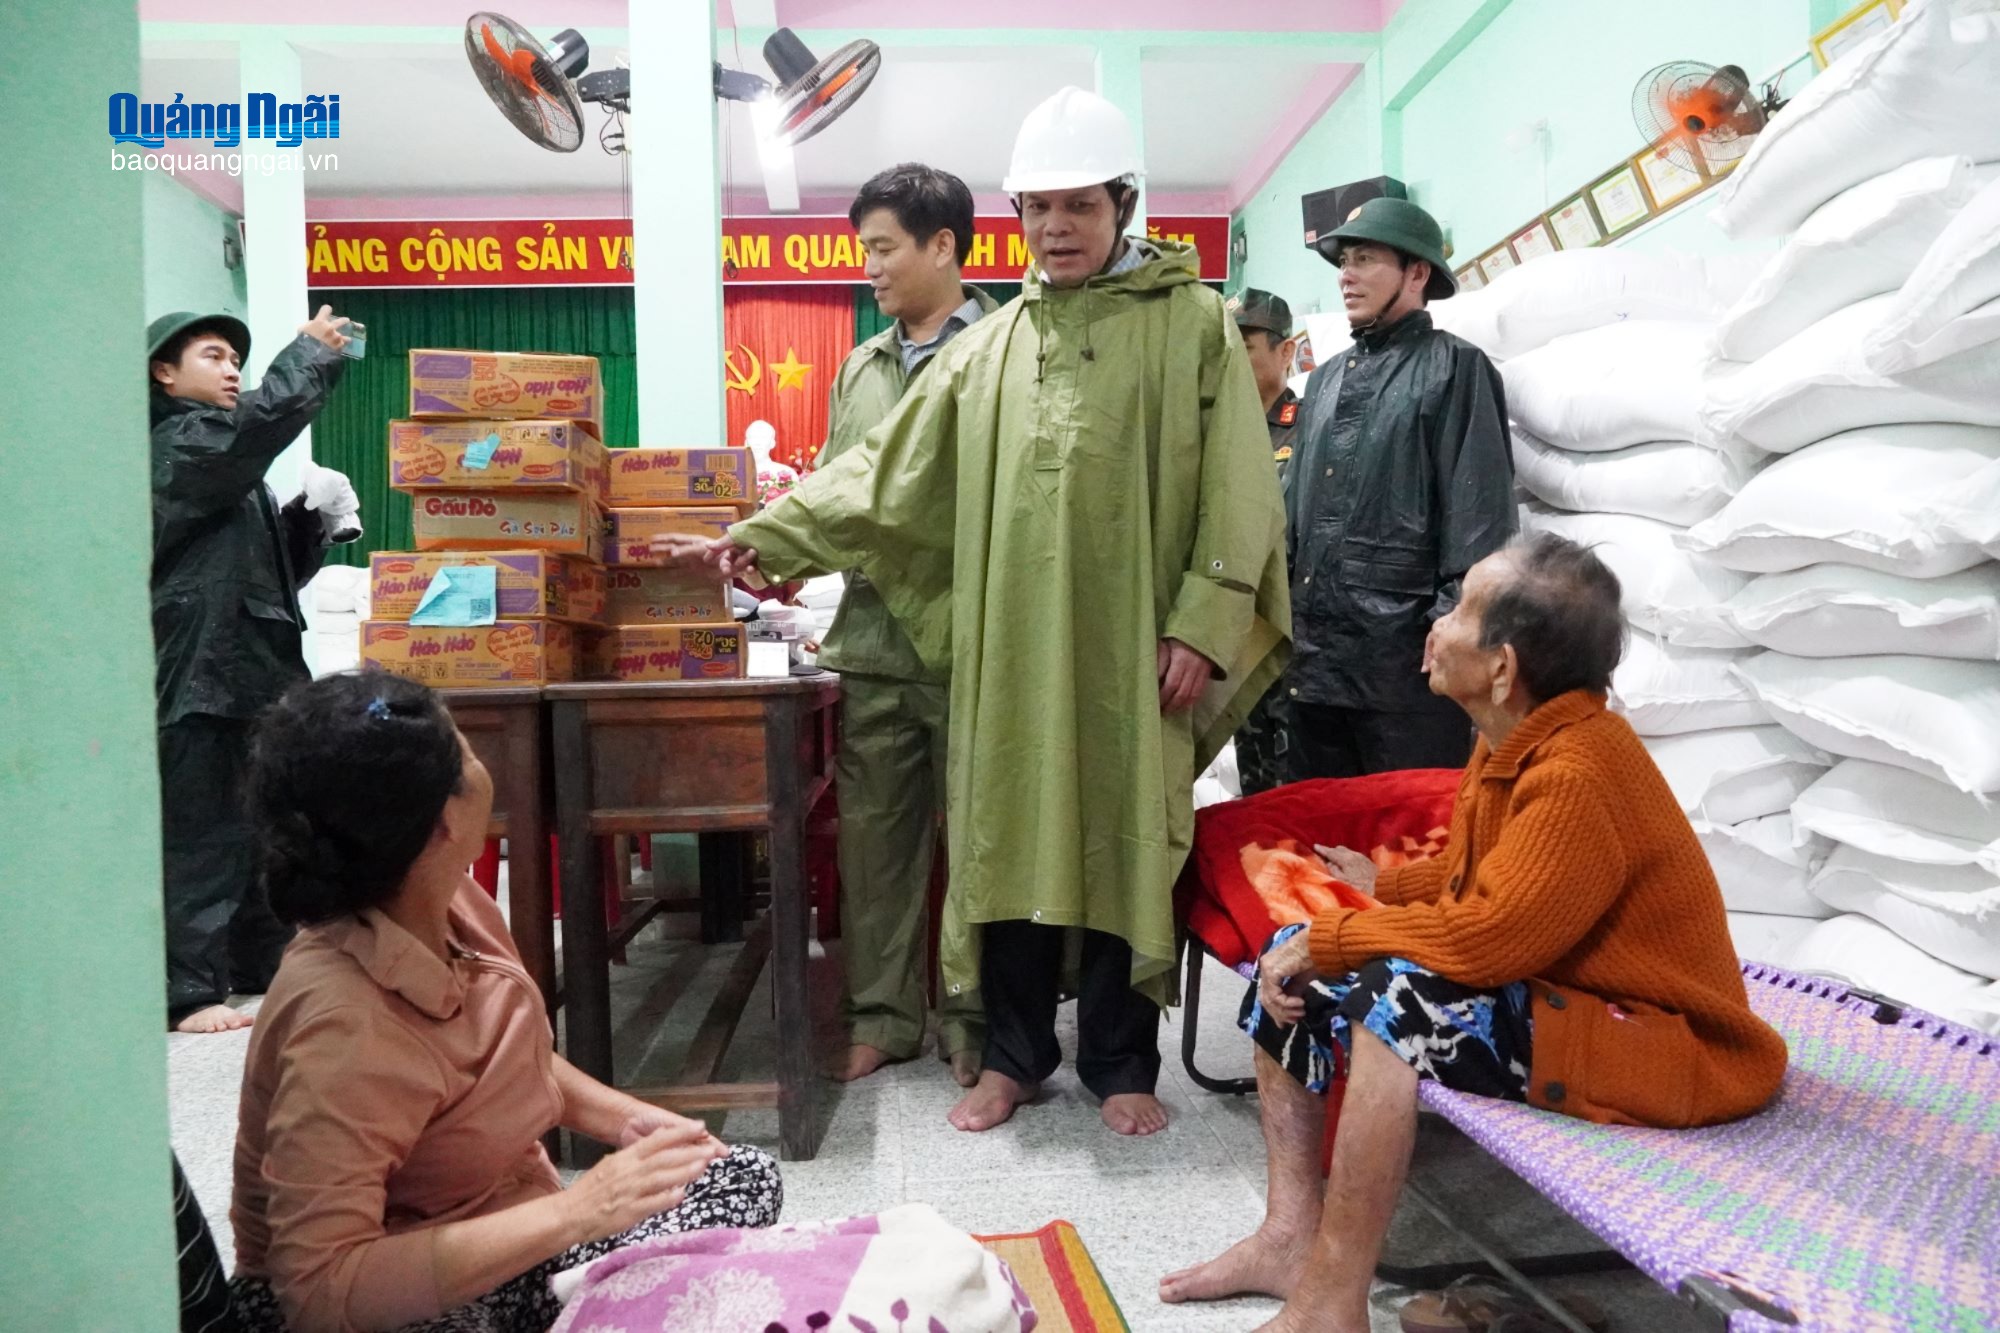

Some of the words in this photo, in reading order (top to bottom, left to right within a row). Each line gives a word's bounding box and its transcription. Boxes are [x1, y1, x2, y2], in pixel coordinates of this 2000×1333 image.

[307, 225, 389, 273] ẢNG
[400, 228, 503, 281] CỘNG
[515, 223, 588, 271] SẢN
[722, 235, 771, 269] AM
[524, 381, 555, 399] Hảo
[556, 379, 588, 398] Hảo
[621, 455, 650, 473] Hảo
[652, 452, 680, 470] Hảo
[425, 497, 466, 517] Gấu
[468, 497, 497, 517] Đỏ
[409, 636, 442, 657] Hảo
[443, 632, 476, 653] Hảo
